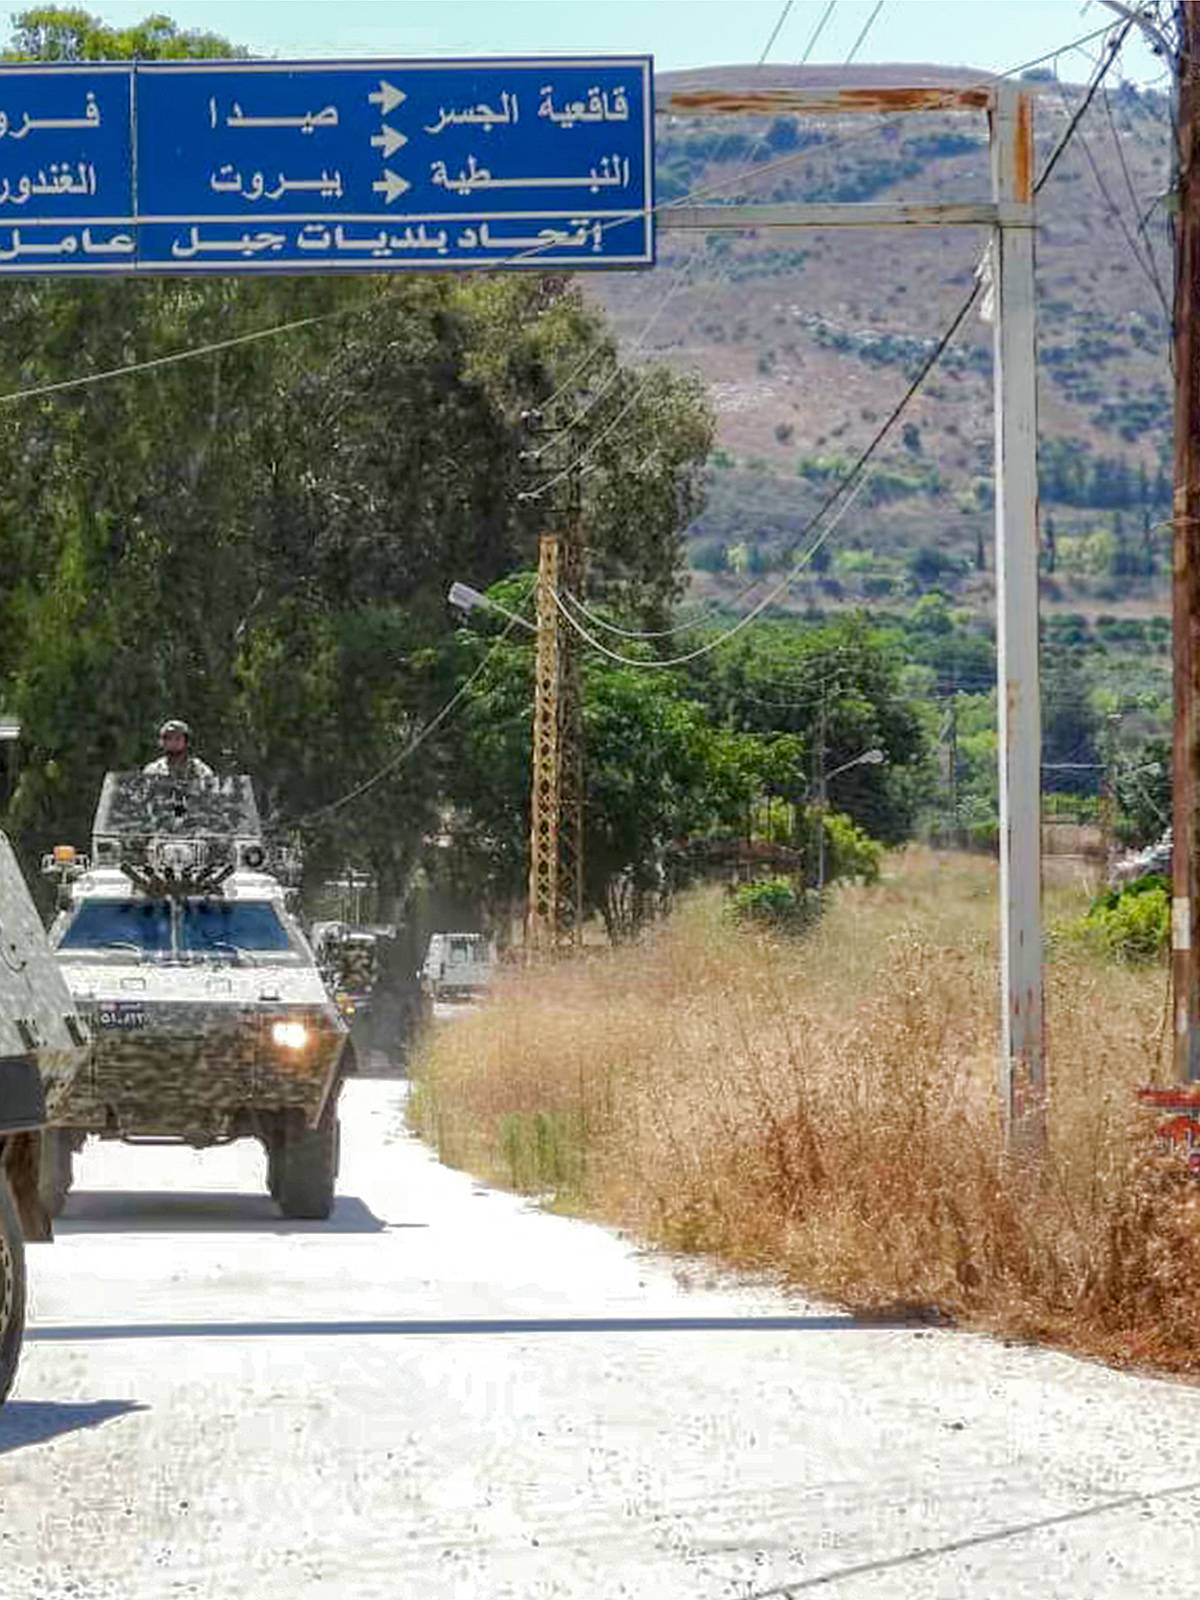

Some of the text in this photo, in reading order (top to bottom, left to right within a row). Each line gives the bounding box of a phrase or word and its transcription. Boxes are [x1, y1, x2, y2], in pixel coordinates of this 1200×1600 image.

[209, 97, 339, 132] صيدا
[424, 86, 630, 133] قاقعية الجسر
[210, 163, 343, 199] بيروت
[430, 154, 630, 195] النبطية
[171, 226, 286, 257] جبل
[297, 223, 449, 257] بلديات
